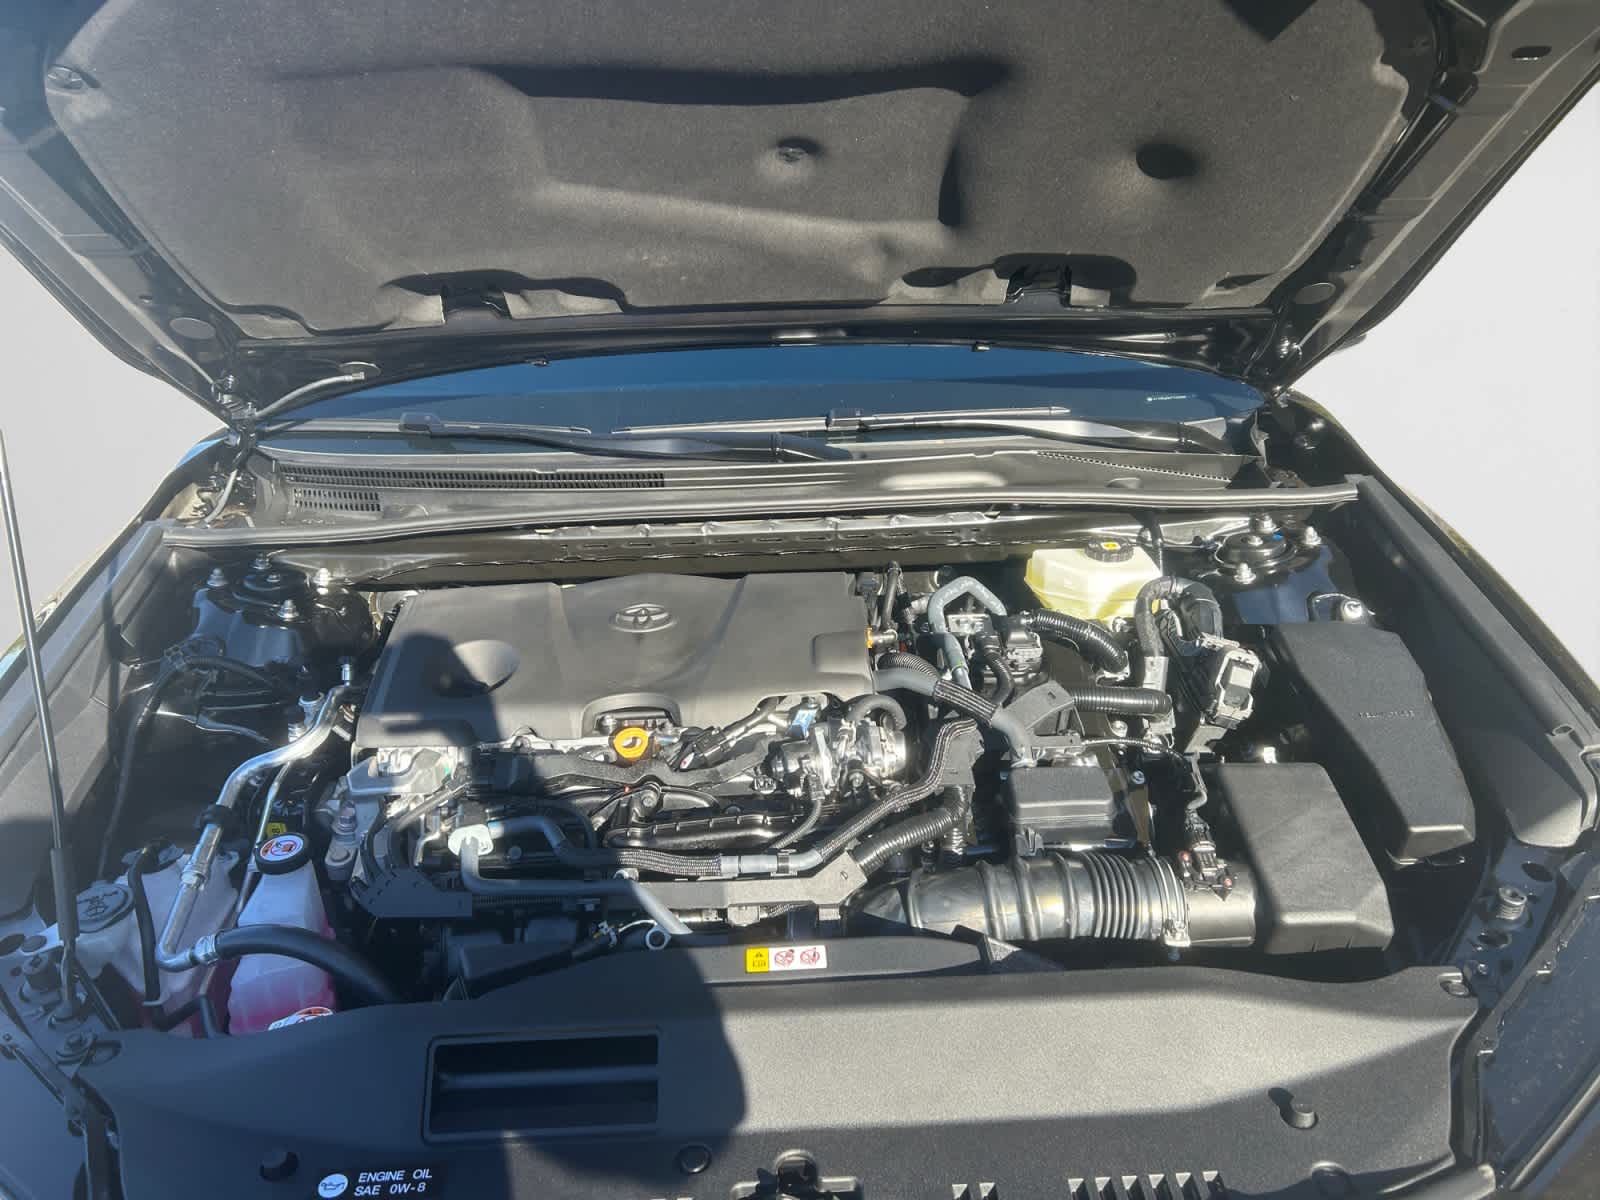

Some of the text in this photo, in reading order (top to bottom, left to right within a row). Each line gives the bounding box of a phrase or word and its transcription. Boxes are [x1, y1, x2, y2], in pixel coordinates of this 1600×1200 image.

[358, 1168, 432, 1183] ENGINE OIL
[354, 1182, 426, 1196] SAE 0W-8
